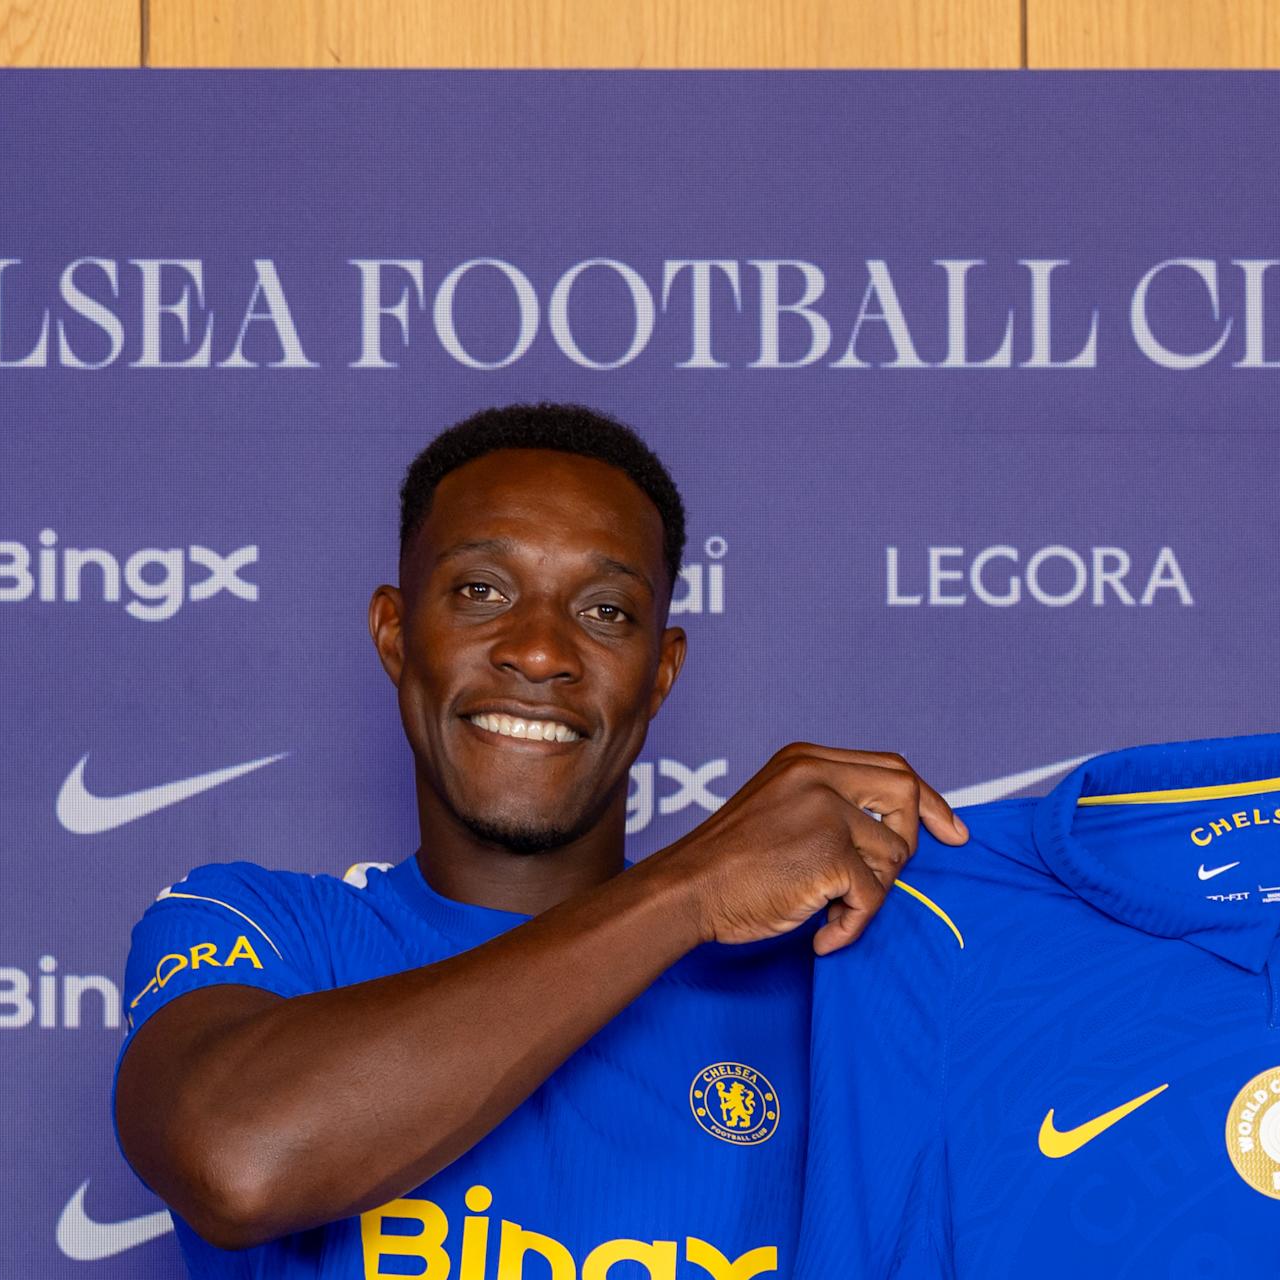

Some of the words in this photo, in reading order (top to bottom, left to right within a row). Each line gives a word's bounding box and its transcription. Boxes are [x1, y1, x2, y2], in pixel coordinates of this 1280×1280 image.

[352, 259, 1097, 369] FOOTBALL
[887, 546, 1193, 606] LEGORA
[703, 1065, 758, 1084] CHELSEA
[710, 1125, 752, 1142] FOOTBALL
[751, 1127, 768, 1140] CLUB
[1237, 1089, 1269, 1154] WORLD
